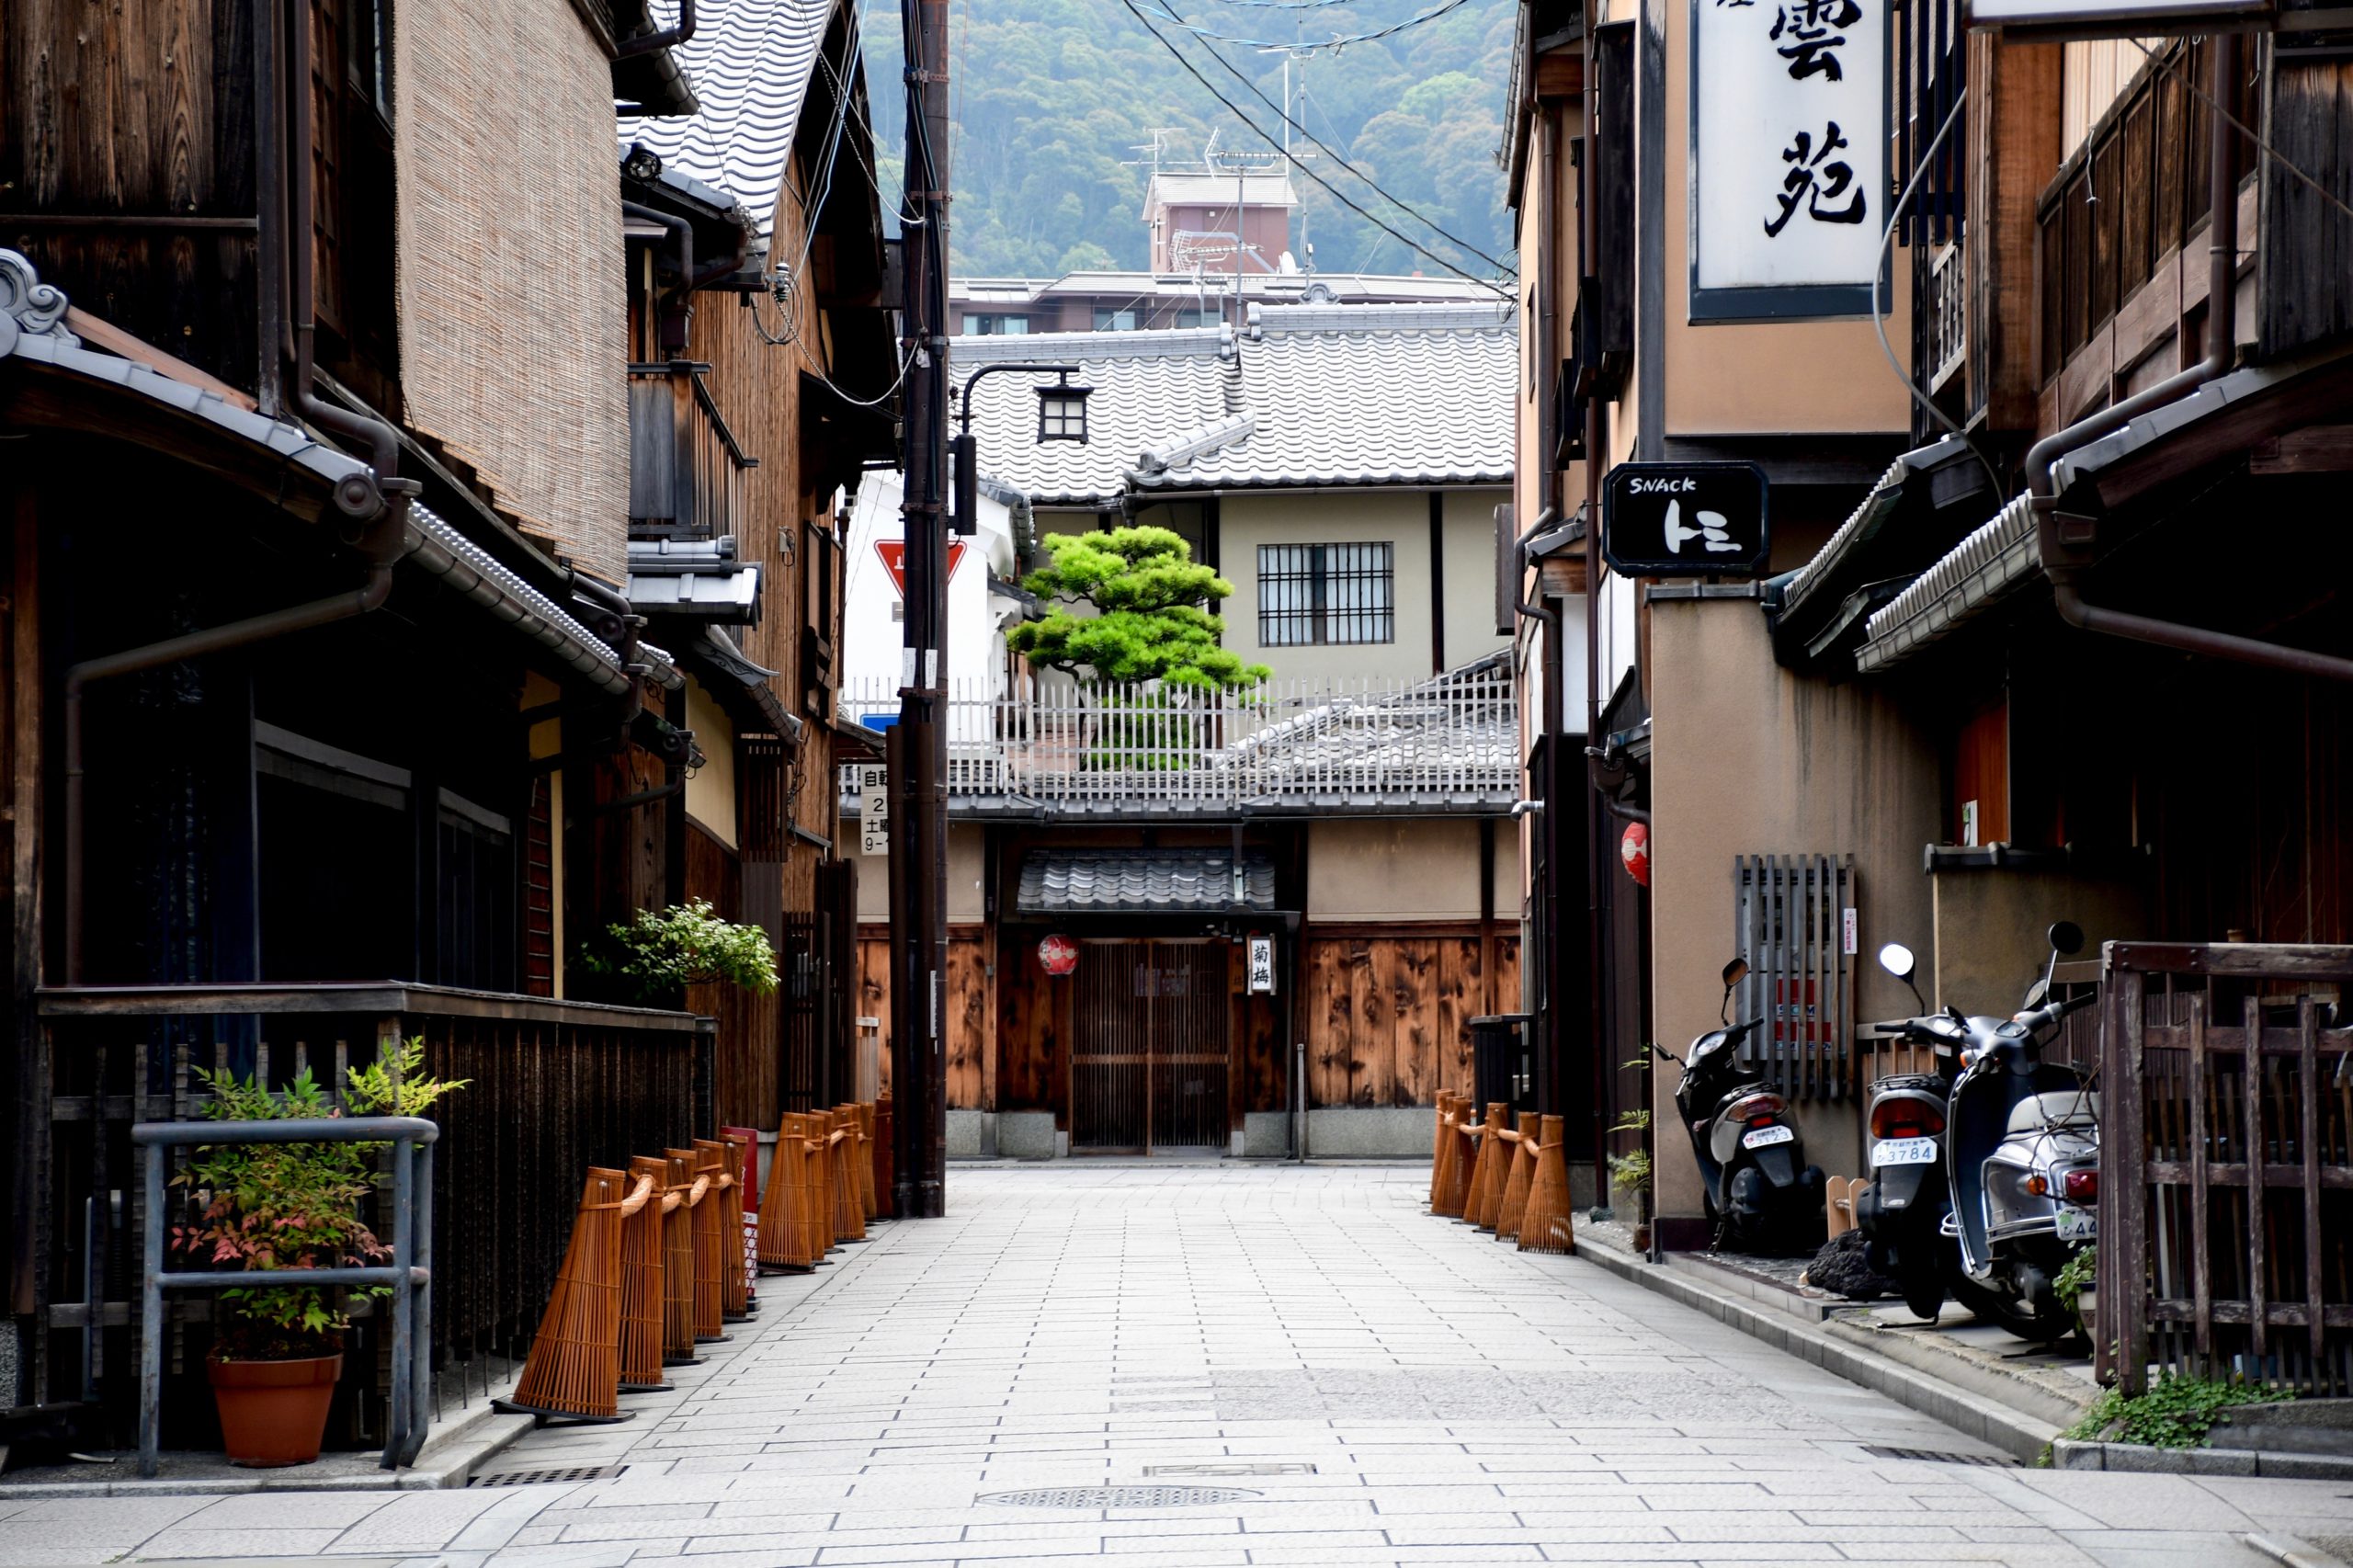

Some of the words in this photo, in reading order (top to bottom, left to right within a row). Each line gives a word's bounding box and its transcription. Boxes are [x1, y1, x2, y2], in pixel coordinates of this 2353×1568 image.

[1630, 476, 1697, 494] SNACK
[1665, 499, 1743, 553] トミ
[873, 798, 884, 812] 2
[865, 837, 888, 851] 9-
[1254, 944, 1269, 983] 菊梅
[1887, 1147, 1932, 1162] 3784
